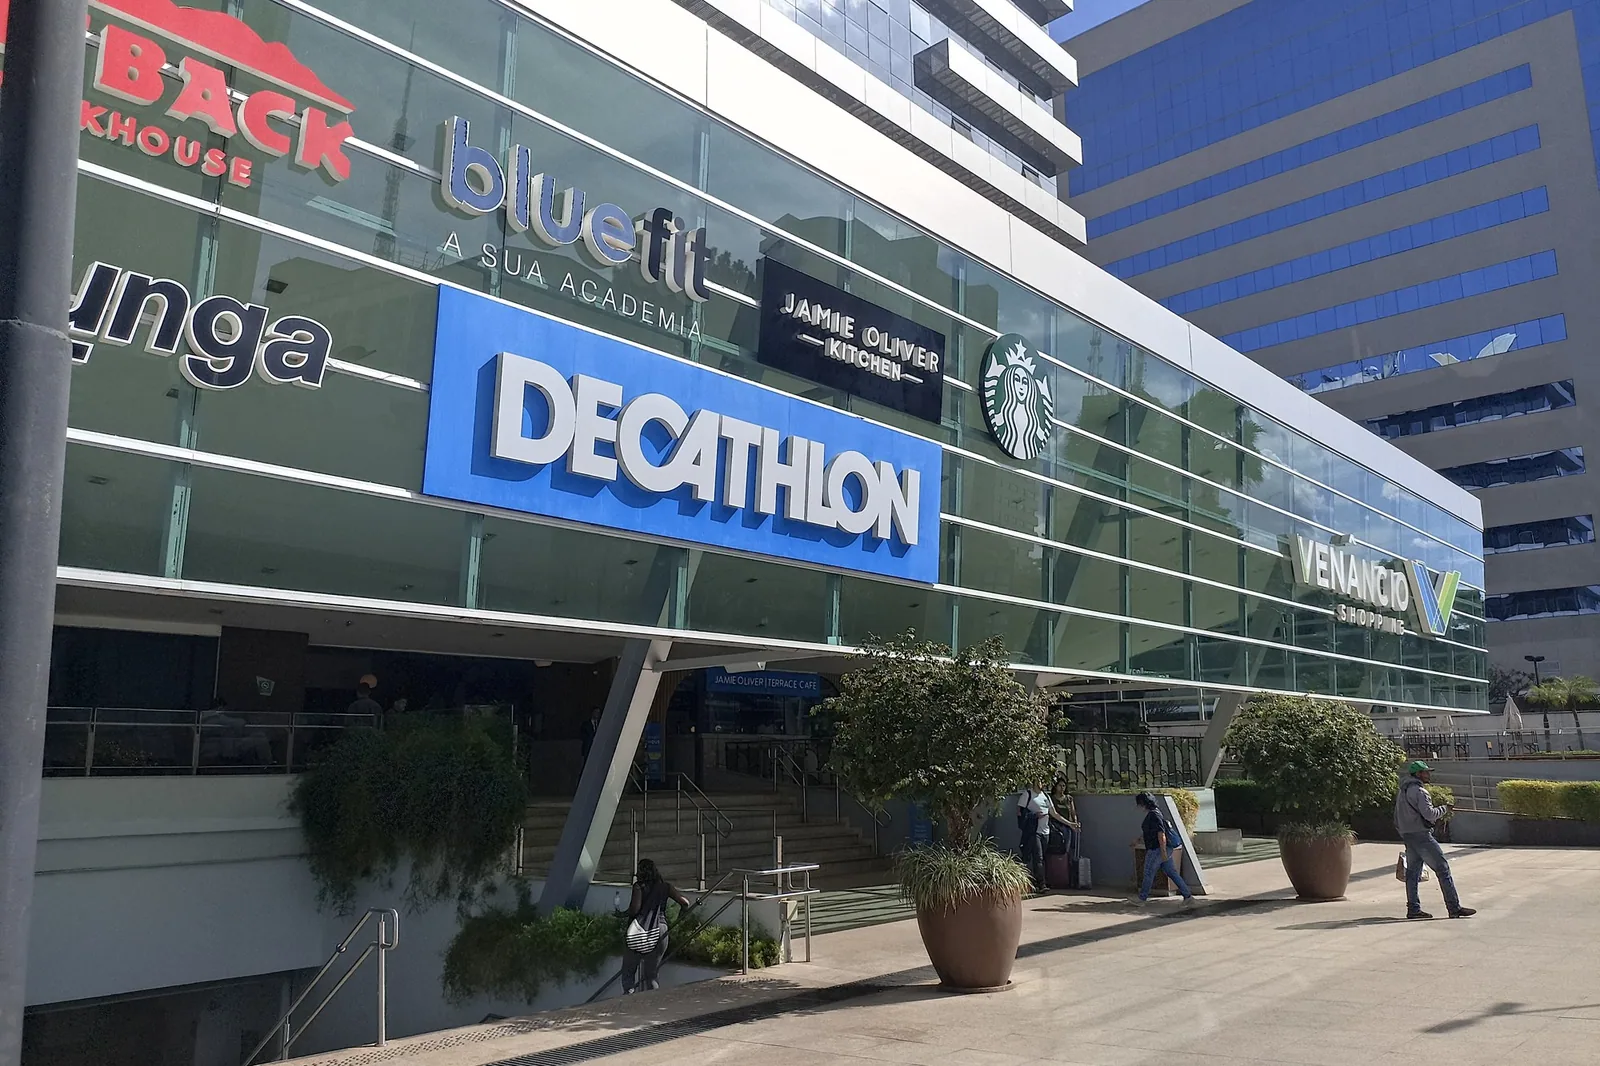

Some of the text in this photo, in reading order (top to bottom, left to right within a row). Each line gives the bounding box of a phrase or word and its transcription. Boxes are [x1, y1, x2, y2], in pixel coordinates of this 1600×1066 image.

[80, 99, 252, 188] KHOUSE
[86, 15, 355, 182] BACK
[441, 115, 711, 303] bluefit
[70, 260, 333, 391] unga
[443, 230, 702, 342] A SUA ACADEMIA
[780, 292, 940, 374] JAMIE OLIVER
[824, 336, 902, 381] KITCHEN
[490, 351, 921, 546] DECATHLON
[1334, 603, 1405, 636] SHOPPING
[715, 675, 737, 684] JAMIE
[737, 676, 764, 687] OLIVER
[768, 678, 797, 689] TERRACE
